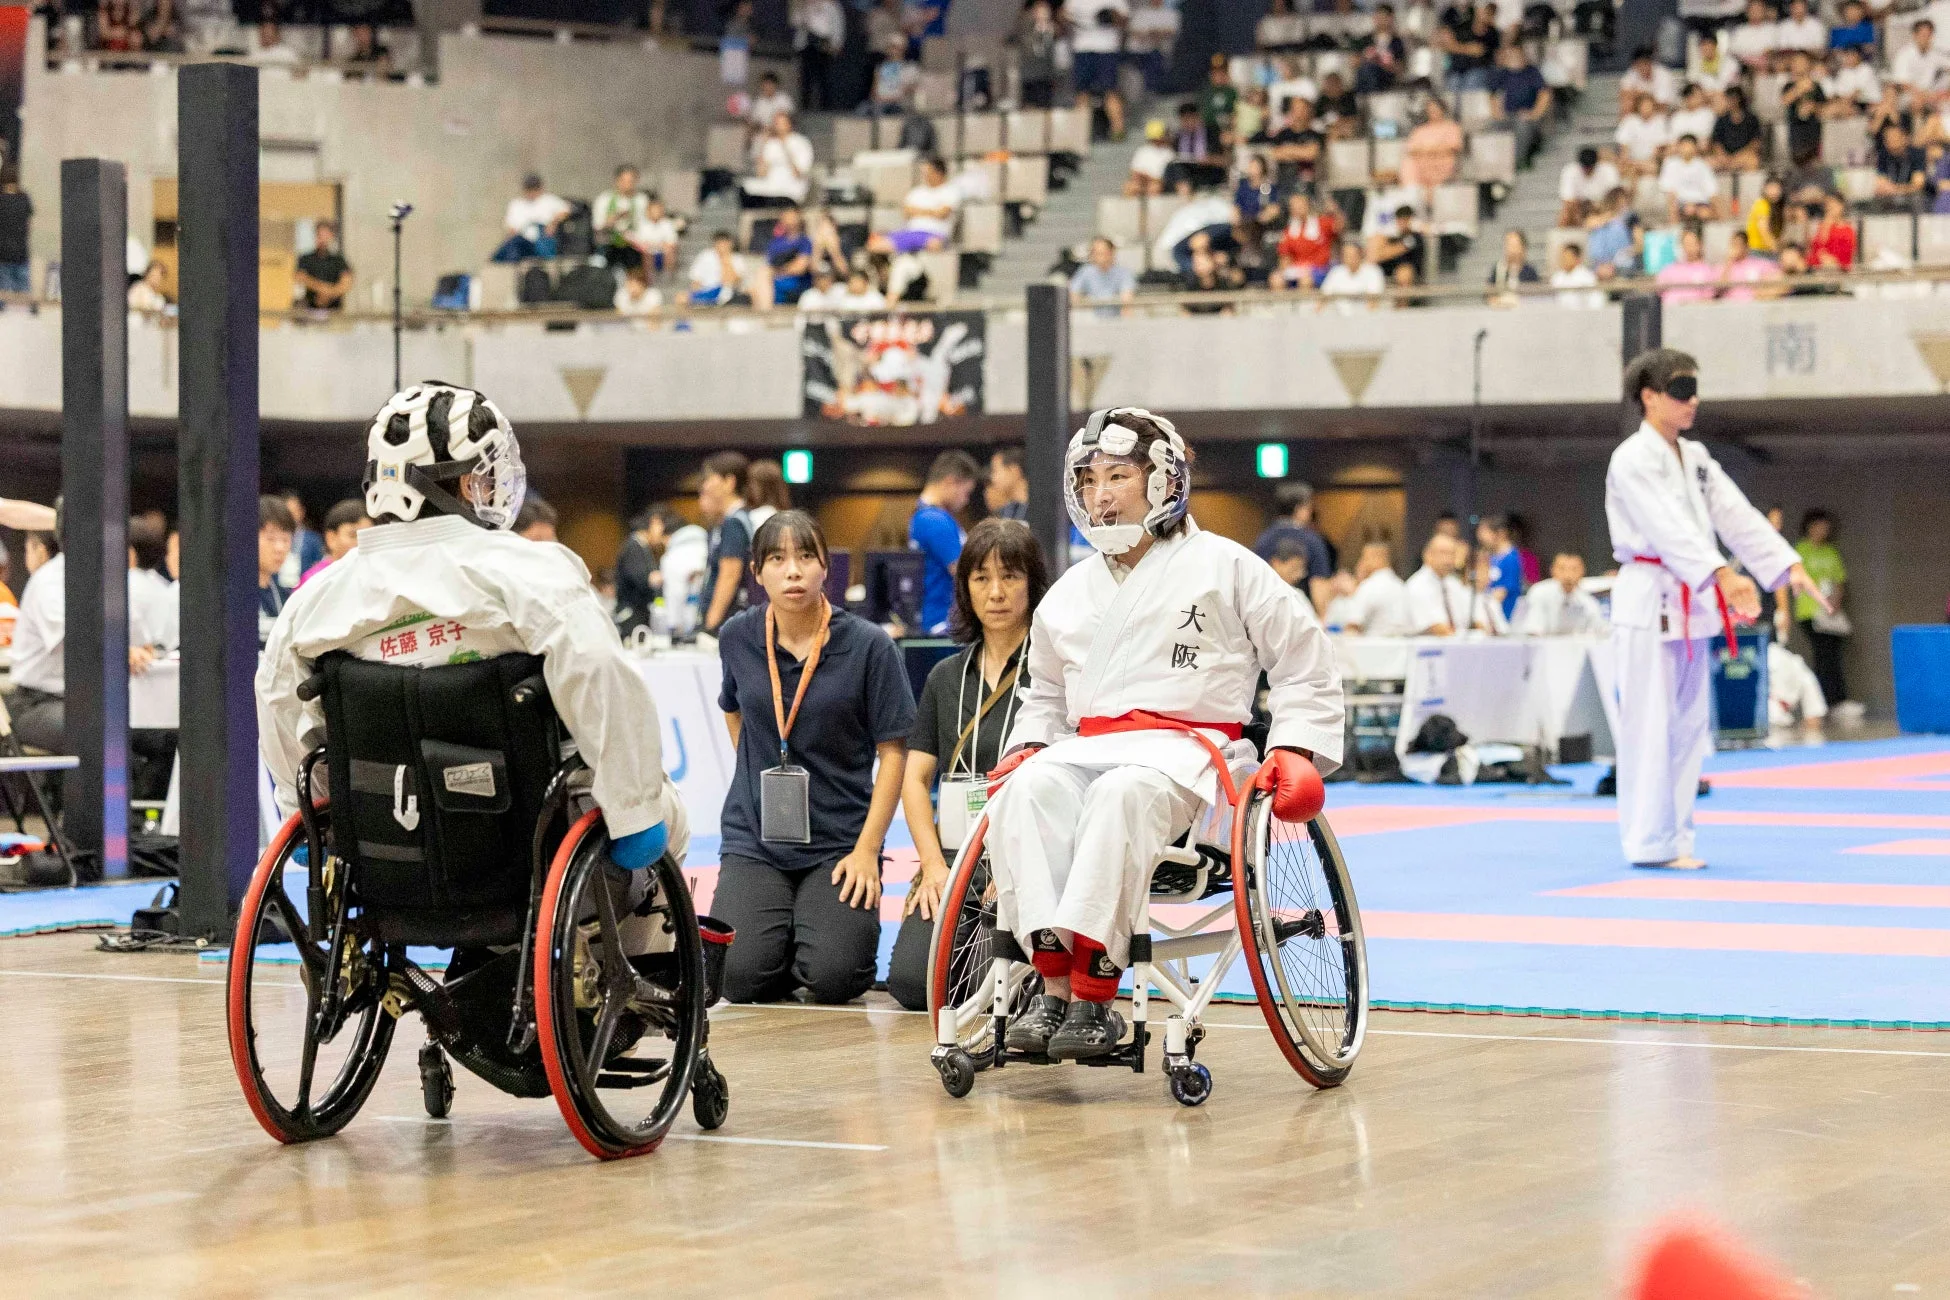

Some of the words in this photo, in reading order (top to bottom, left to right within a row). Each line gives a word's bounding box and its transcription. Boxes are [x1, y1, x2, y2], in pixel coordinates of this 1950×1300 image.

[380, 630, 418, 660] 佐藤
[426, 620, 467, 647] 京子
[1171, 604, 1207, 670] 大阪
